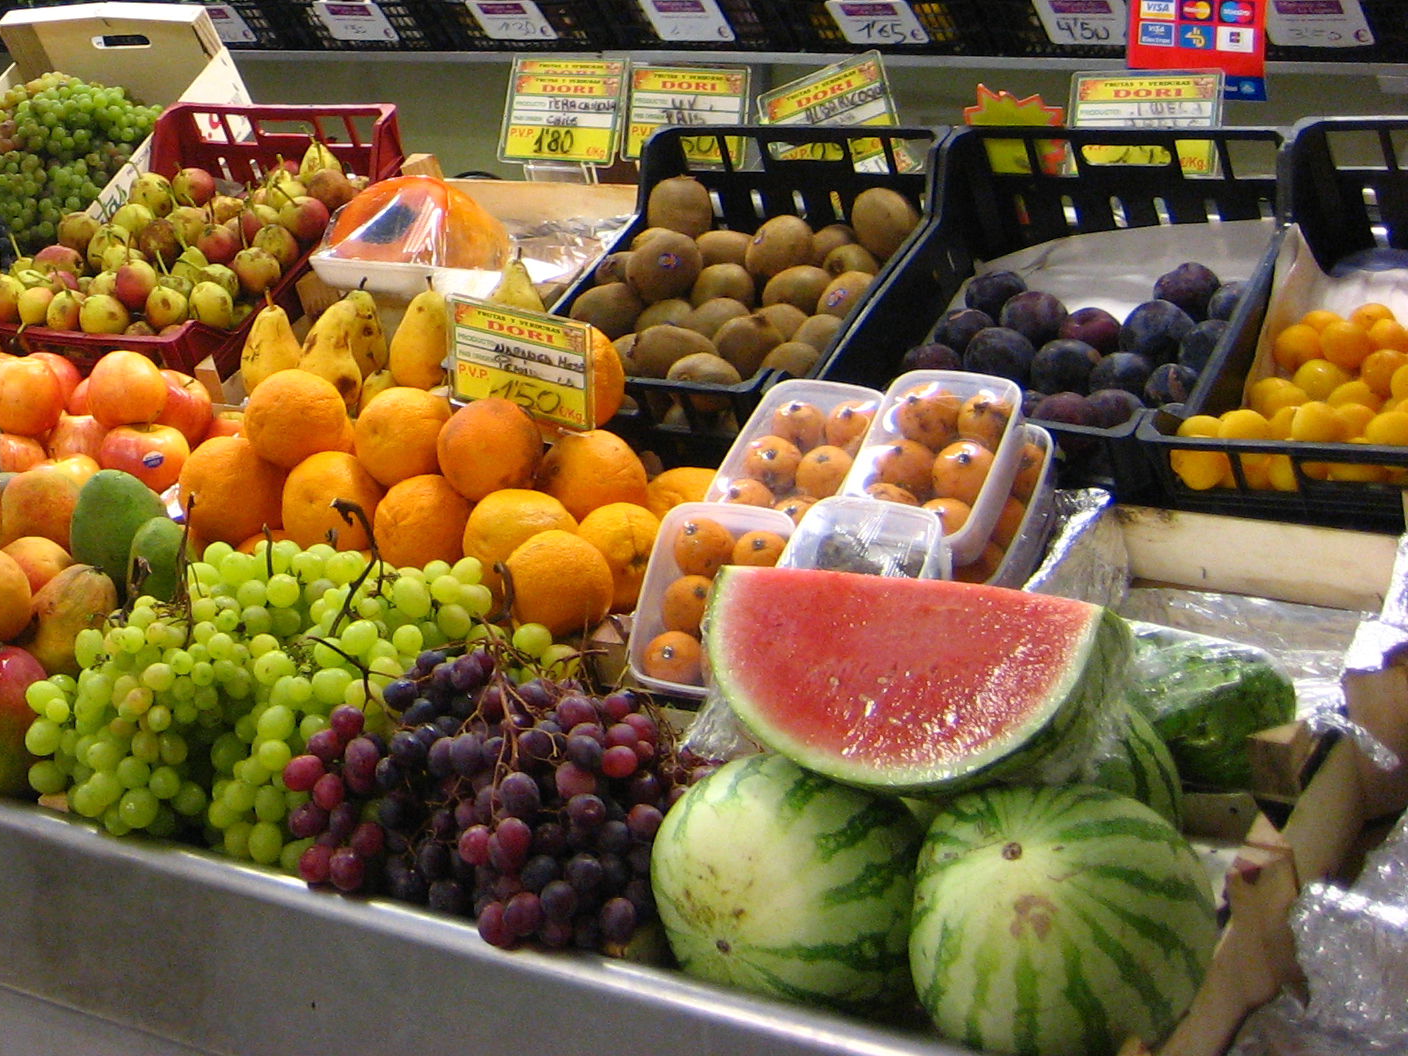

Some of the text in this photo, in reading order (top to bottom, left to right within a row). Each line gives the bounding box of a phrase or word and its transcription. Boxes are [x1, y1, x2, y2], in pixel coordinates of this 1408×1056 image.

[1146, 2, 1170, 13] VISA
[856, 20, 907, 45] 1'65
[1148, 25, 1165, 33] VISA
[542, 84, 596, 94] DORI
[661, 80, 718, 92] DORI
[795, 79, 854, 108] DORI
[1112, 88, 1184, 98] DORI
[509, 127, 534, 138] P.V.P.
[533, 127, 574, 154] 1'80
[487, 320, 555, 344] DORI
[458, 363, 490, 381] P.V.P.
